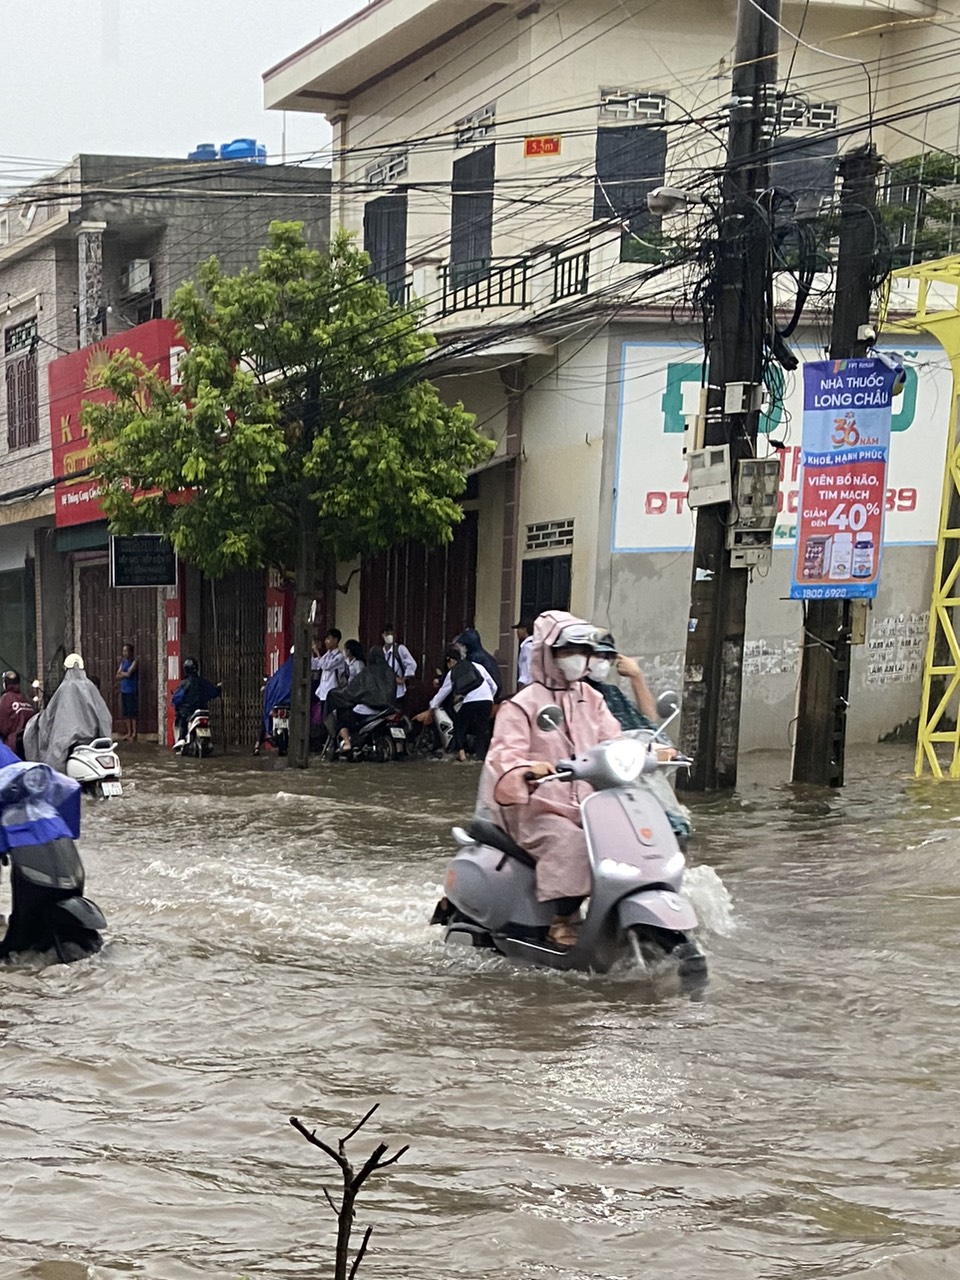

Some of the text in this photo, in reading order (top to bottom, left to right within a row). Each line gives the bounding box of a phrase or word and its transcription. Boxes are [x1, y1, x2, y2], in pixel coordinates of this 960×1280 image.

[820, 372, 884, 390] NHÀ THUỐC
[814, 389, 889, 407] LONG CHÂU
[835, 452, 858, 464] HẠNH
[859, 448, 883, 460] PHÚC
[808, 473, 834, 486] VIÊN
[818, 489, 870, 502] TIM MẠCH
[803, 507, 827, 518] GIẢM
[810, 519, 826, 528] ĐẾN
